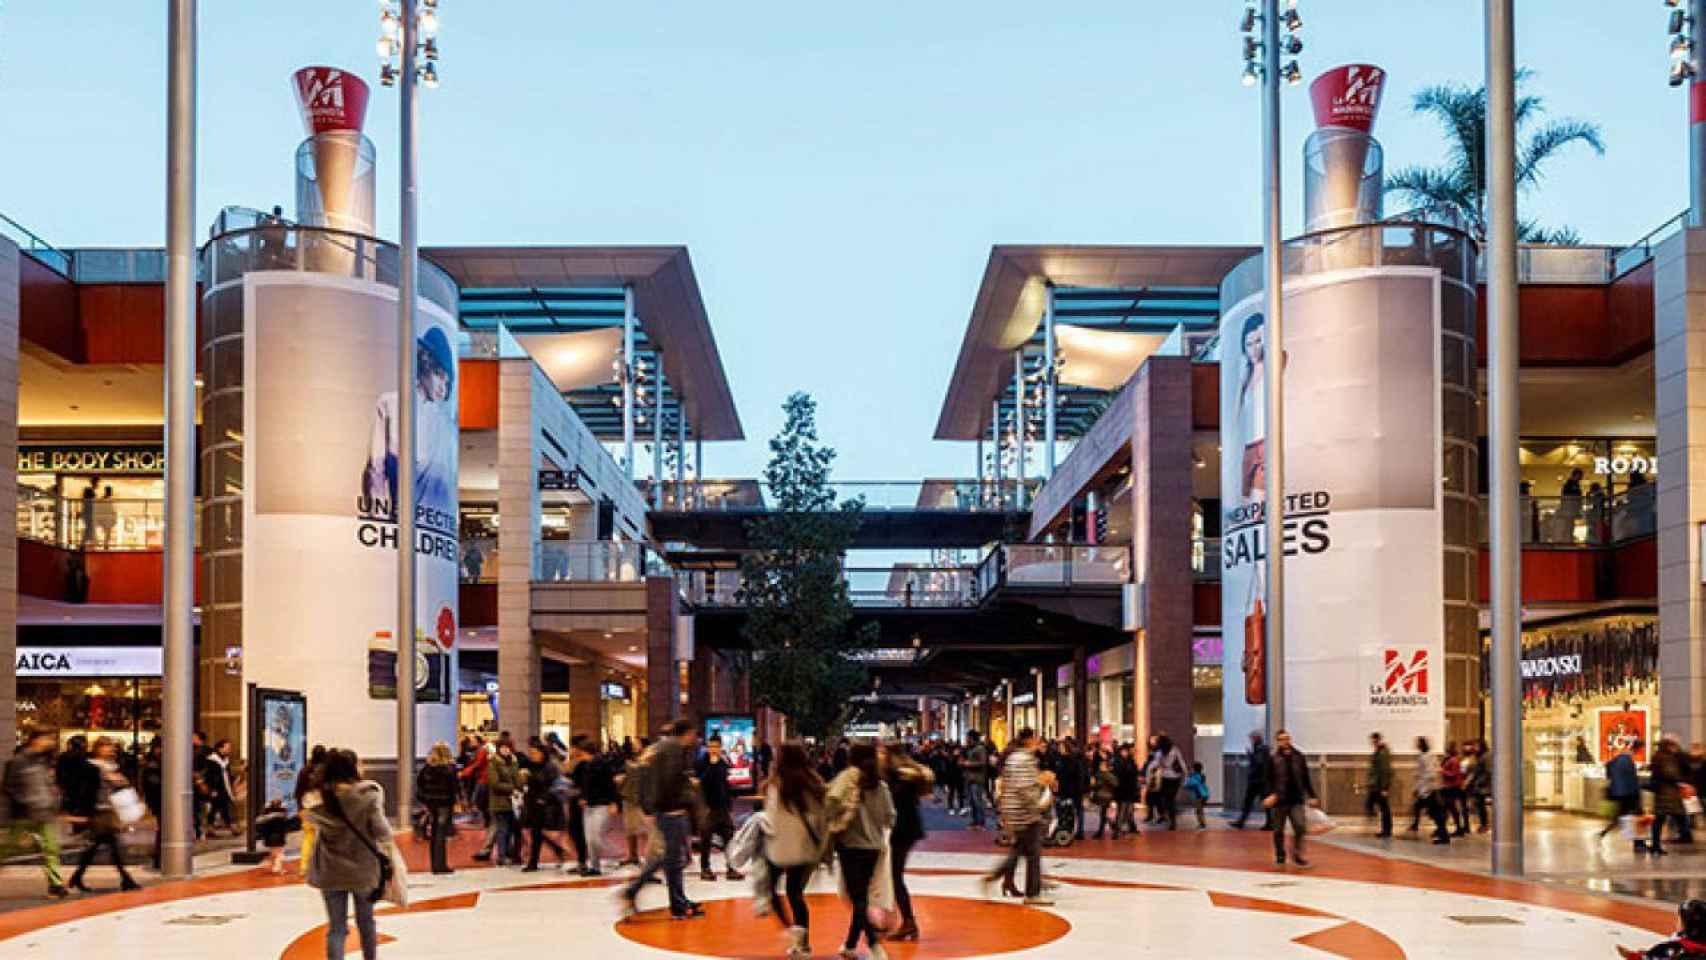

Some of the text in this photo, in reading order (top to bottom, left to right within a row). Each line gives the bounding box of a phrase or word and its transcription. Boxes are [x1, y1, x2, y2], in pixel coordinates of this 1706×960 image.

[17, 452, 46, 469] HE
[52, 452, 108, 469] BODY
[357, 523, 457, 561] CHLDRE
[1224, 519, 1330, 568] SALES
[16, 653, 70, 670] AICA
[1519, 655, 1581, 677] WAROVSKI
